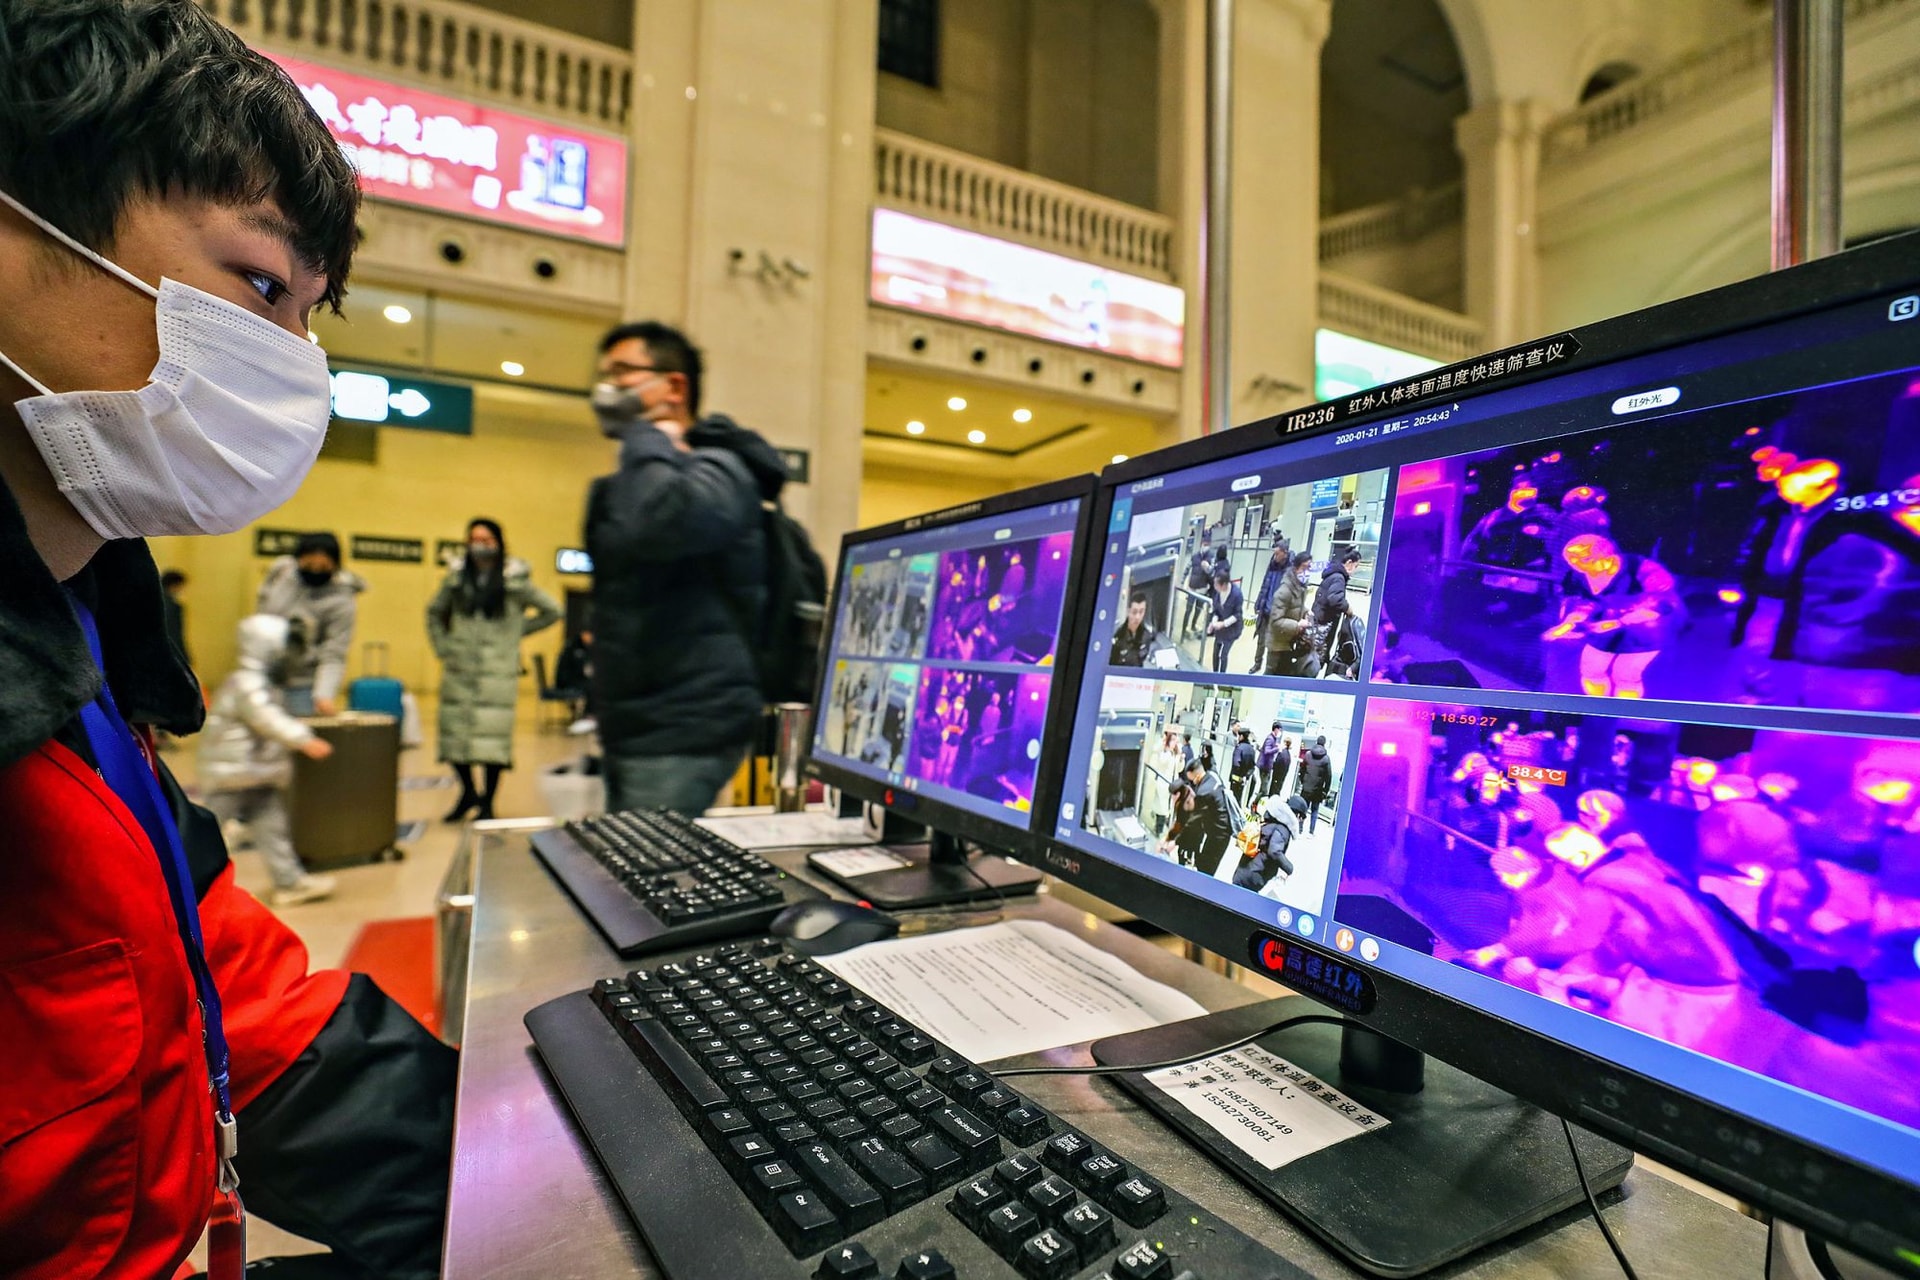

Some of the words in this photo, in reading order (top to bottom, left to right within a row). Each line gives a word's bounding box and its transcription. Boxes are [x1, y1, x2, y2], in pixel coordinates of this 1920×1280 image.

[1286, 406, 1335, 433] IR236
[1347, 343, 1565, 414] 红外人体表面温度快速筛查仪
[1628, 394, 1662, 408] 红外光
[1335, 428, 1378, 445] 2020-01-21
[1382, 420, 1410, 434] 星期二
[1413, 410, 1450, 426] 20:54:43
[1441, 713, 1498, 727] 18:59:27
[673, 1002, 684, 1010] X
[712, 999, 724, 1007] D
[685, 1014, 696, 1022] C
[768, 1008, 780, 1016] T
[698, 1026, 709, 1034] V
[739, 1023, 751, 1031] G
[711, 1040, 723, 1048] B
[753, 1036, 766, 1045] H
[799, 1034, 811, 1043] U
[725, 1055, 738, 1063] N
[785, 1066, 798, 1074] K
[834, 1063, 846, 1072] O
[741, 1070, 754, 1079] M
[803, 1082, 814, 1090] L
[853, 1079, 866, 1087] P
[1241, 1047, 1377, 1126] 红外体温筛查设备
[1201, 1091, 1275, 1142] 15342730081
[1218, 1086, 1293, 1135] 15827507149
[953, 1116, 981, 1137] Backspace
[869, 1137, 885, 1151] Enter
[1010, 1158, 1027, 1172] Insert
[971, 1181, 988, 1197] Delete
[1041, 1180, 1060, 1196] Home
[1002, 1207, 1018, 1220] End
[1073, 1210, 1085, 1221] Up
[1082, 1205, 1098, 1220] Page
[1044, 1233, 1060, 1249] Page
[1034, 1240, 1053, 1256] Down
[1140, 1242, 1158, 1260] Num
[1132, 1247, 1153, 1265] Lock
